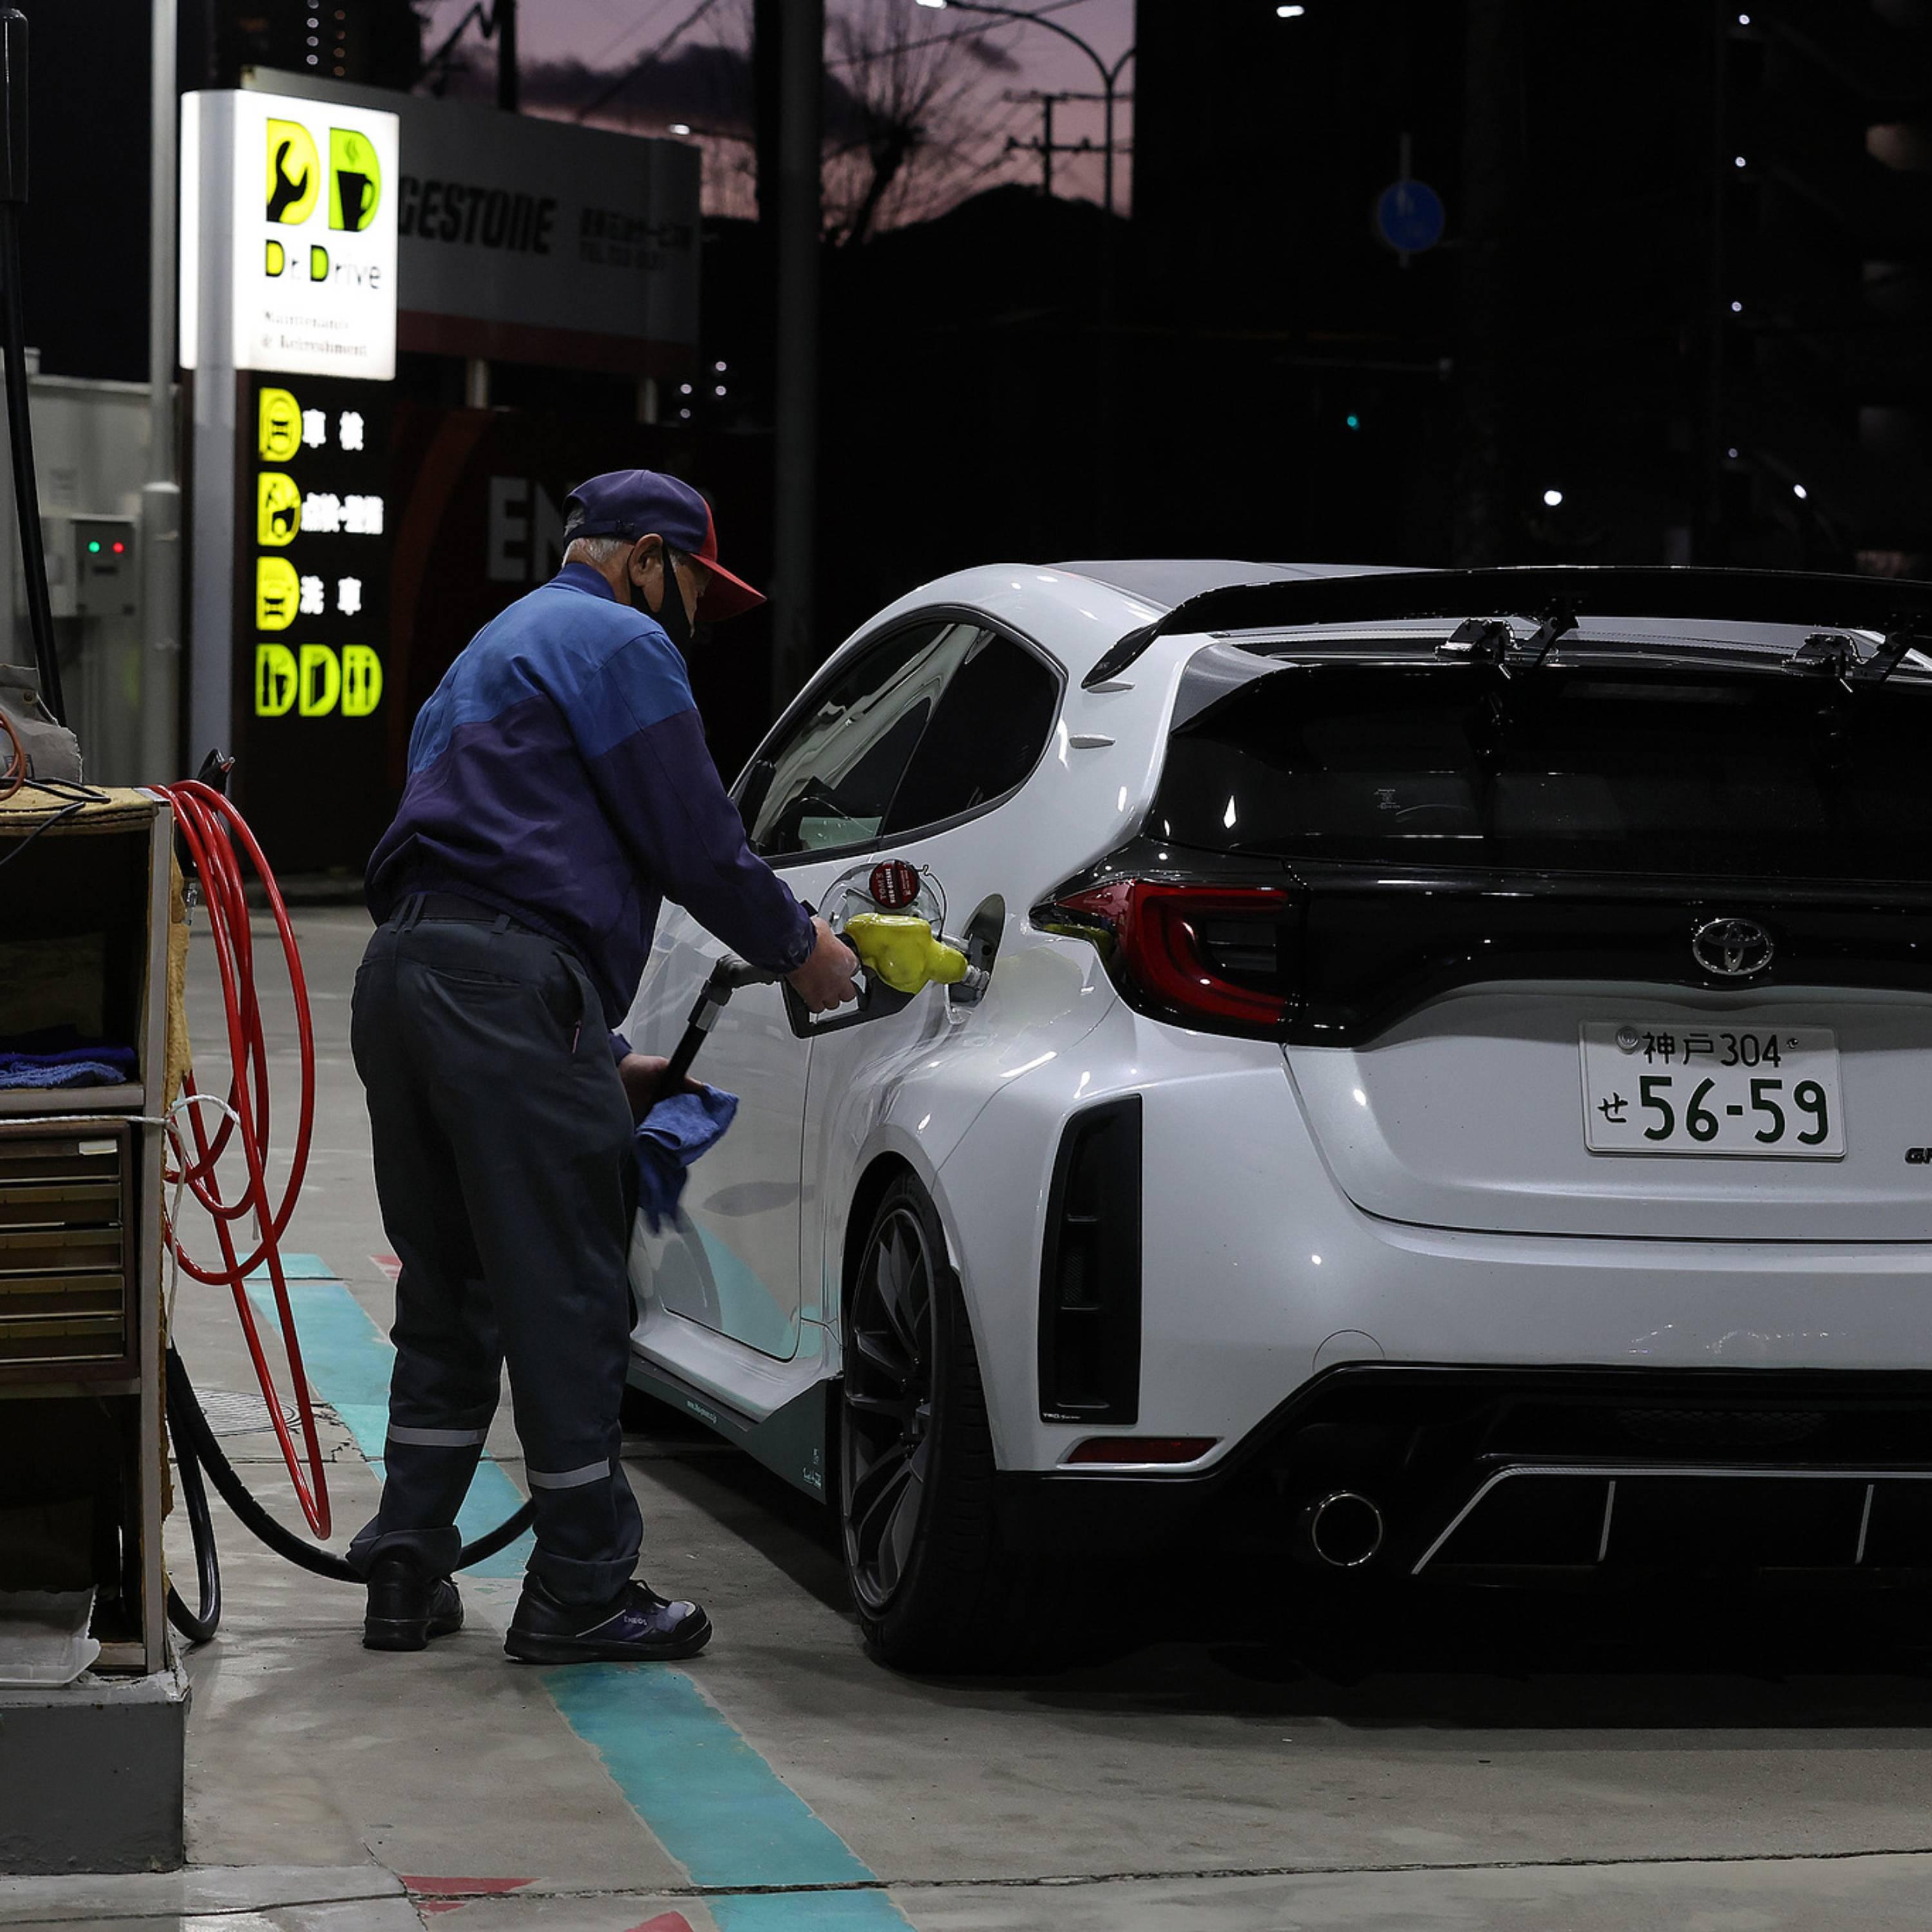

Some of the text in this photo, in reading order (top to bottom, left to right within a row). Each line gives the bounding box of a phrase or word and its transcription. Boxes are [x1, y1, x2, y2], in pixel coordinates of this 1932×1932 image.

[310, 244, 381, 289] Drive
[1597, 1075, 1828, 1145] せ 56-59
